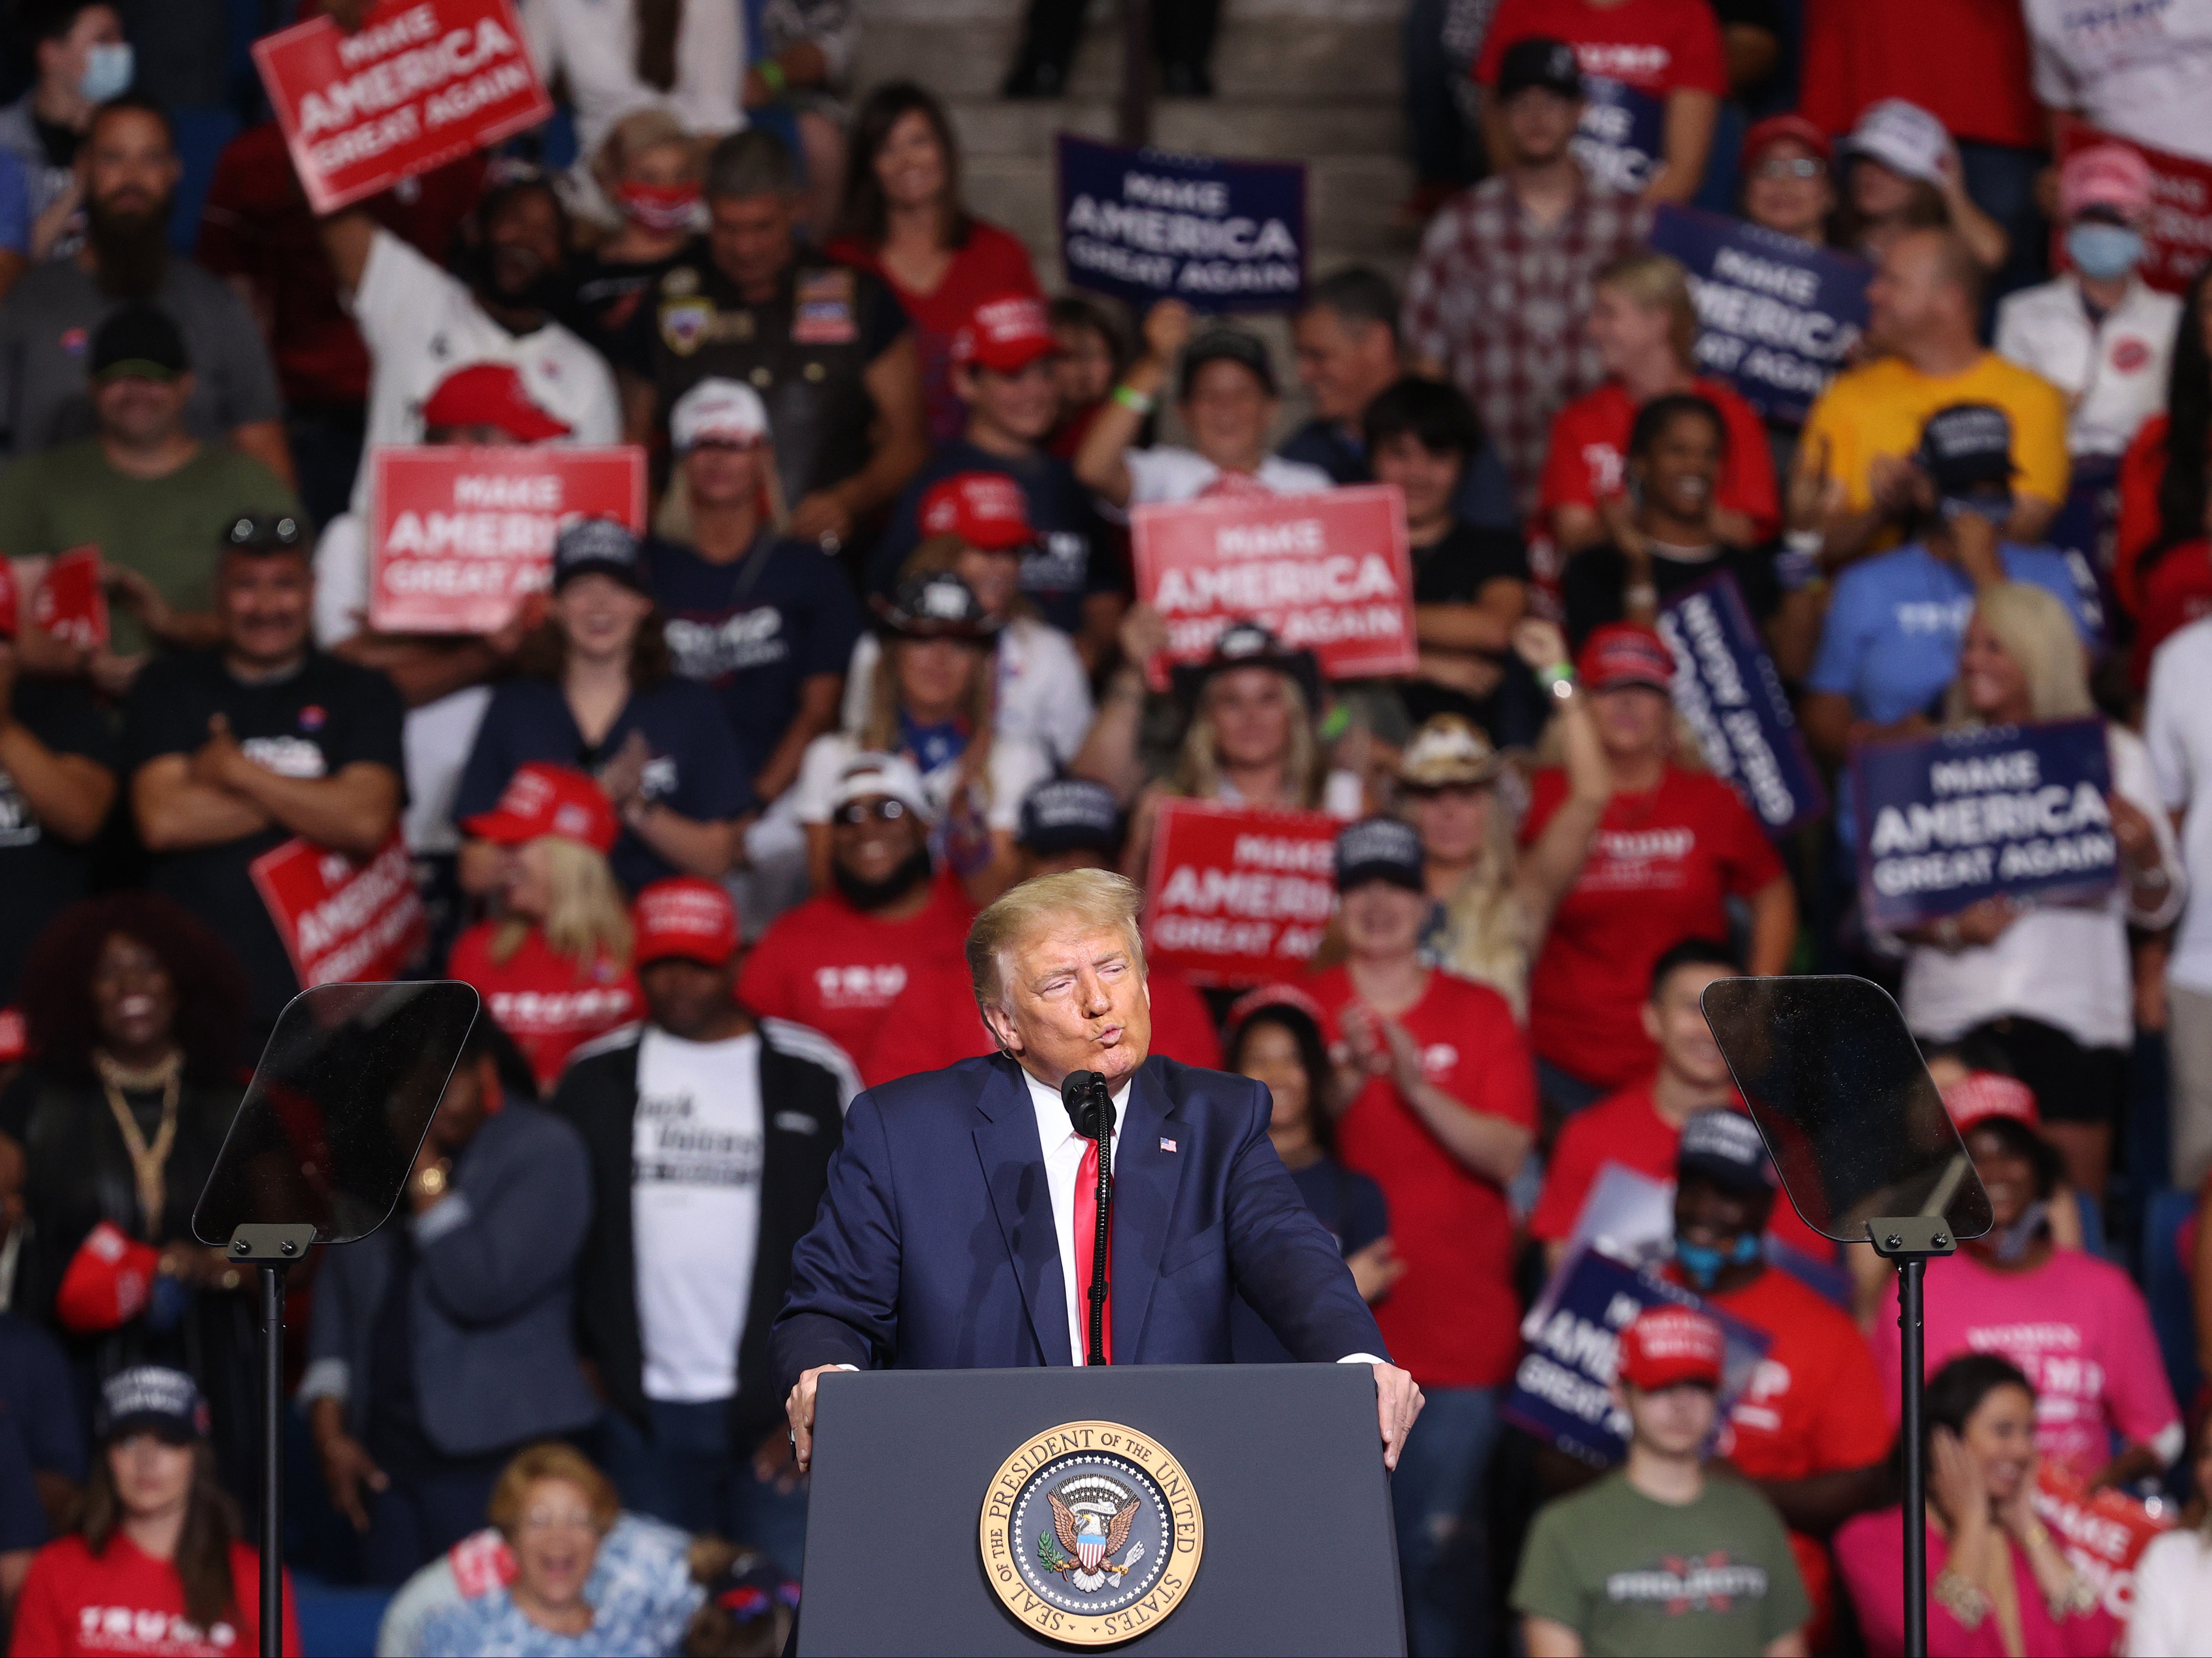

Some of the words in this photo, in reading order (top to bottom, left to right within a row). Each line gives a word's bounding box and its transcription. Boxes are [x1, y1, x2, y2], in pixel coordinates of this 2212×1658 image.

[298, 17, 514, 135] AMERICA
[311, 104, 421, 169] GREAT
[424, 62, 529, 126] AGAIN
[1124, 169, 1228, 215] MAKE
[1066, 193, 1299, 260] AMERICA
[1067, 236, 1173, 286] GREAT
[1176, 260, 1301, 294] AGAIN
[1713, 244, 1822, 305] MAKE
[454, 474, 563, 506] MAKE
[1216, 519, 1321, 558] MAKE
[383, 560, 504, 595] GREAT
[1154, 553, 1400, 612] AMERICA
[1284, 605, 1403, 643] AGAIN
[1931, 749, 2041, 794] MAKE
[1871, 782, 2111, 852] AMERICA
[1873, 848, 1992, 896] GREAT
[1998, 831, 2116, 881] AGAIN
[1152, 914, 1272, 953] GREAT
[489, 988, 634, 1023] TRUMP
[1101, 1432, 1121, 1447] OF
[1125, 1439, 1152, 1462] THE
[988, 1429, 1094, 1520] PRESIDENT
[1155, 1461, 1196, 1553] UNITED
[991, 1528, 1005, 1559] THE
[996, 1563, 1012, 1582] OF
[1010, 1584, 1065, 1631] SEAL
[1104, 1573, 1182, 1636] STATES
